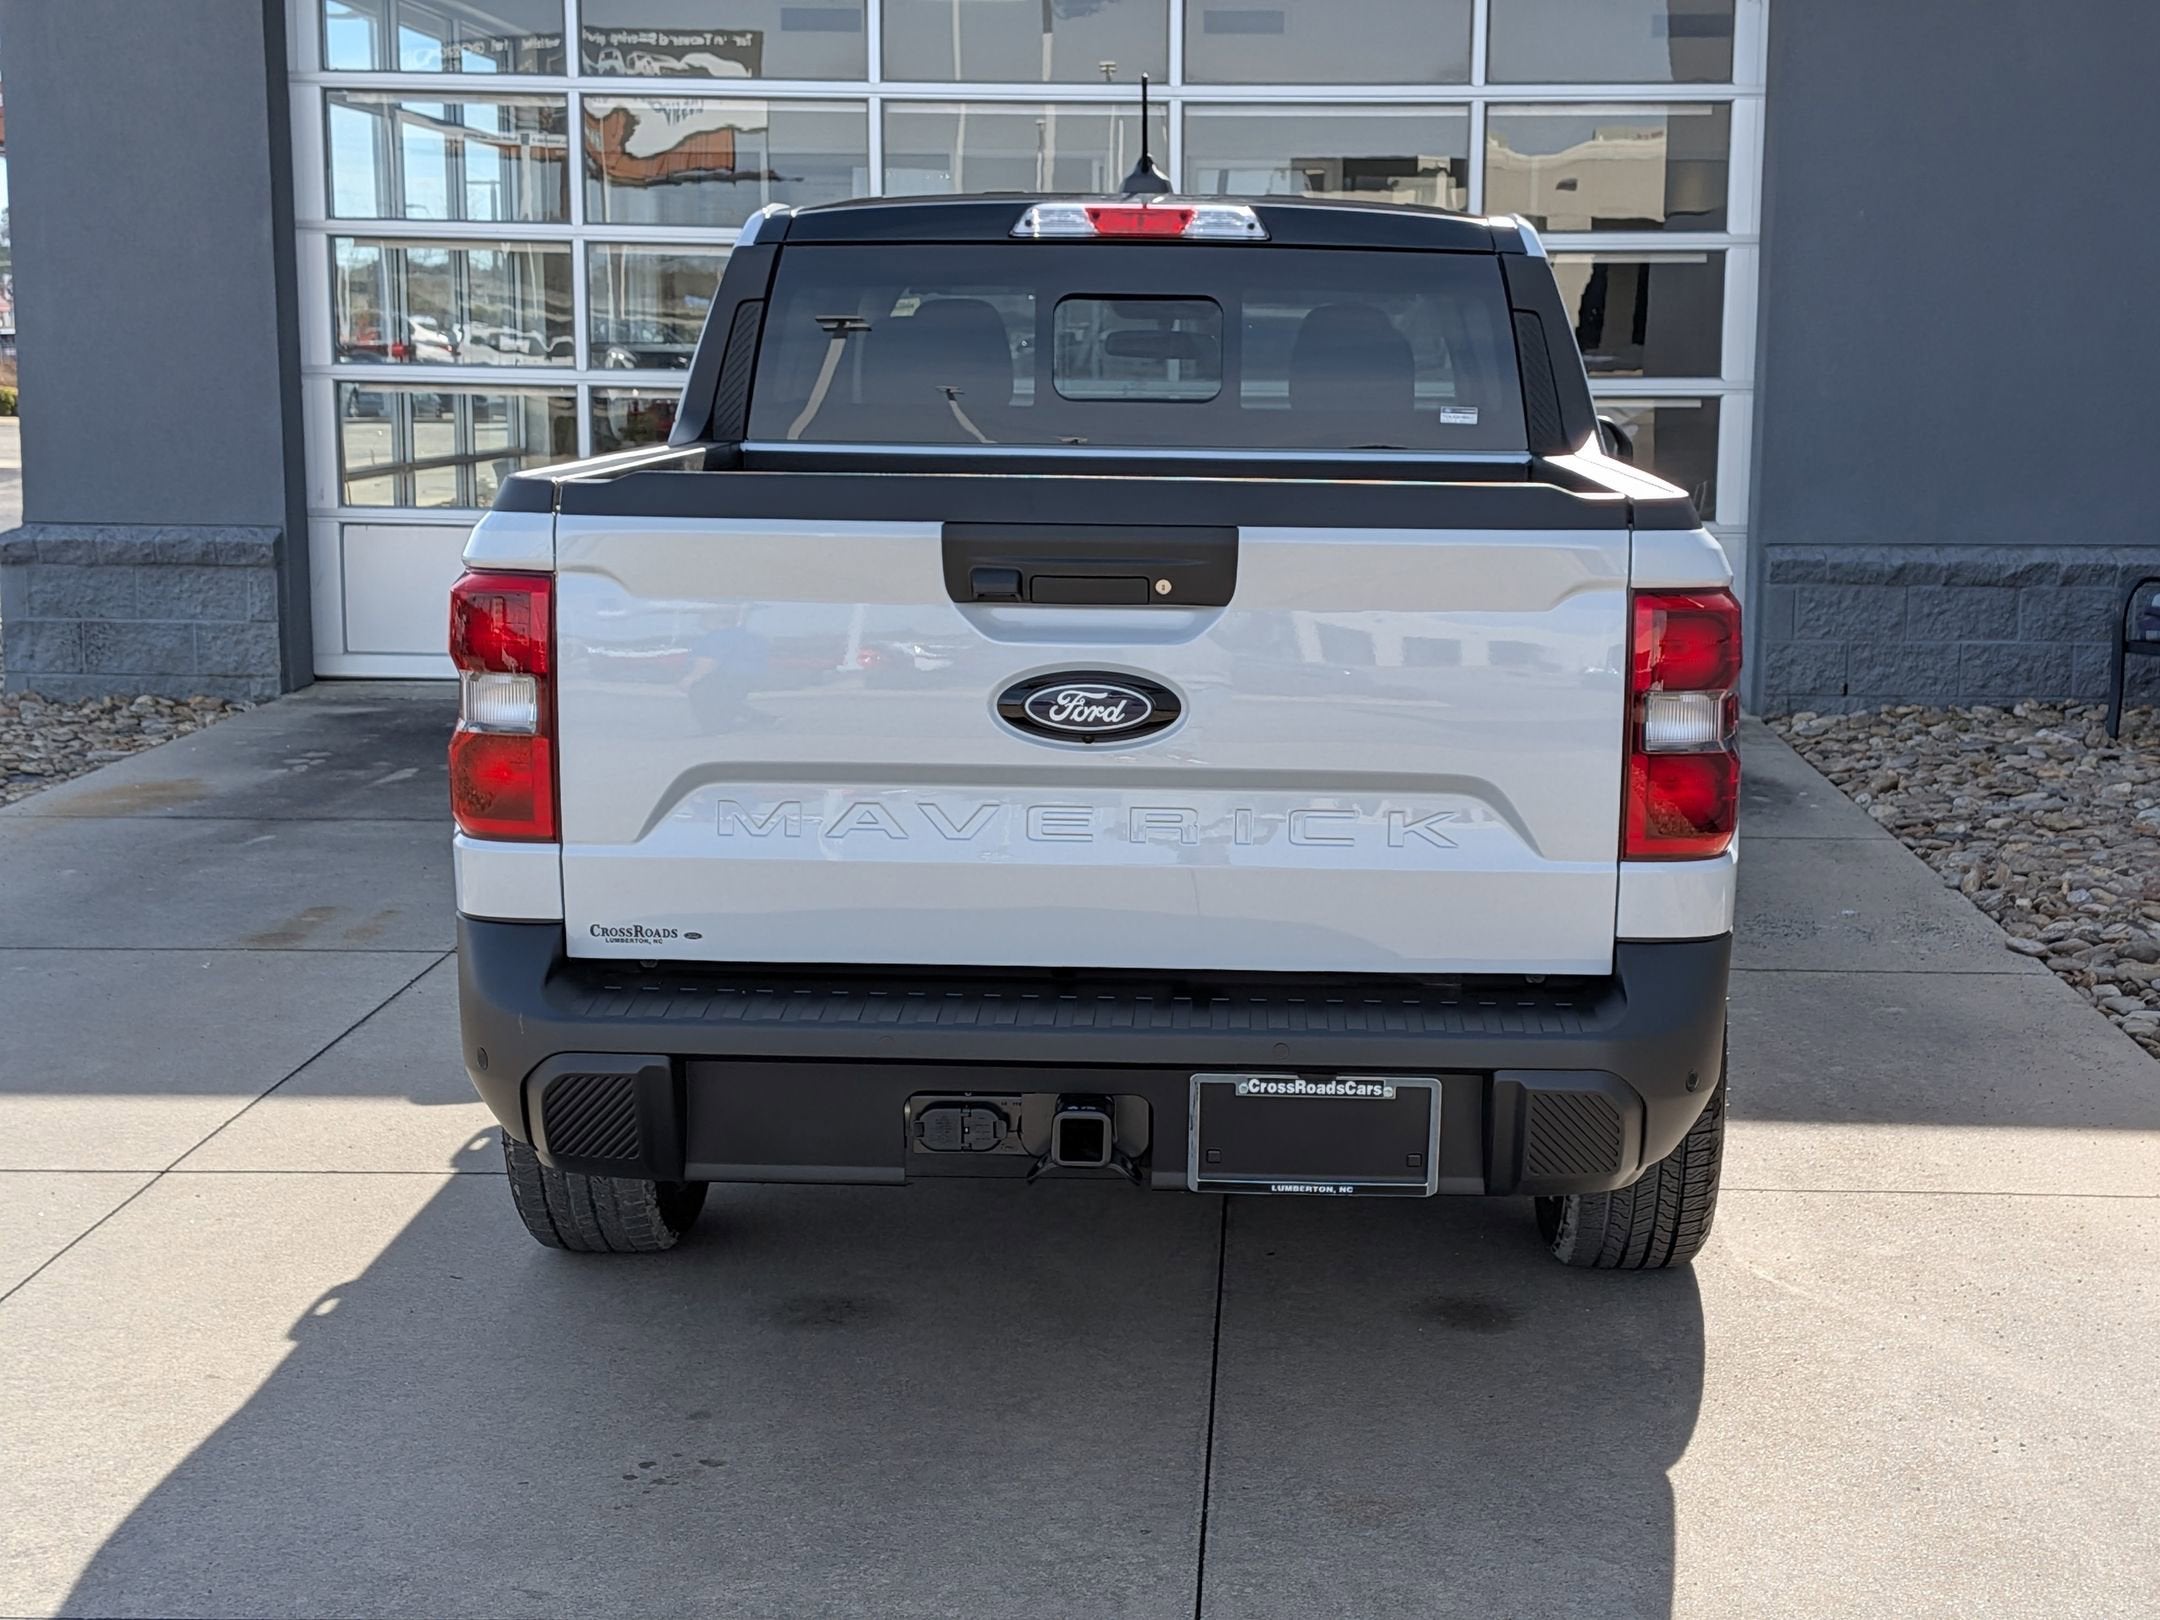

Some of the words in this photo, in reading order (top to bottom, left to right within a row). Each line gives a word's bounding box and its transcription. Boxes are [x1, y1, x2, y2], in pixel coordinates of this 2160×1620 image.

[1049, 690, 1128, 722] Ford
[716, 799, 1459, 848] MAVERICK
[1248, 1078, 1382, 1096] CrossRoadsCars
[1271, 1184, 1337, 1194] LUMBERTON,
[1339, 1186, 1354, 1194] NC
